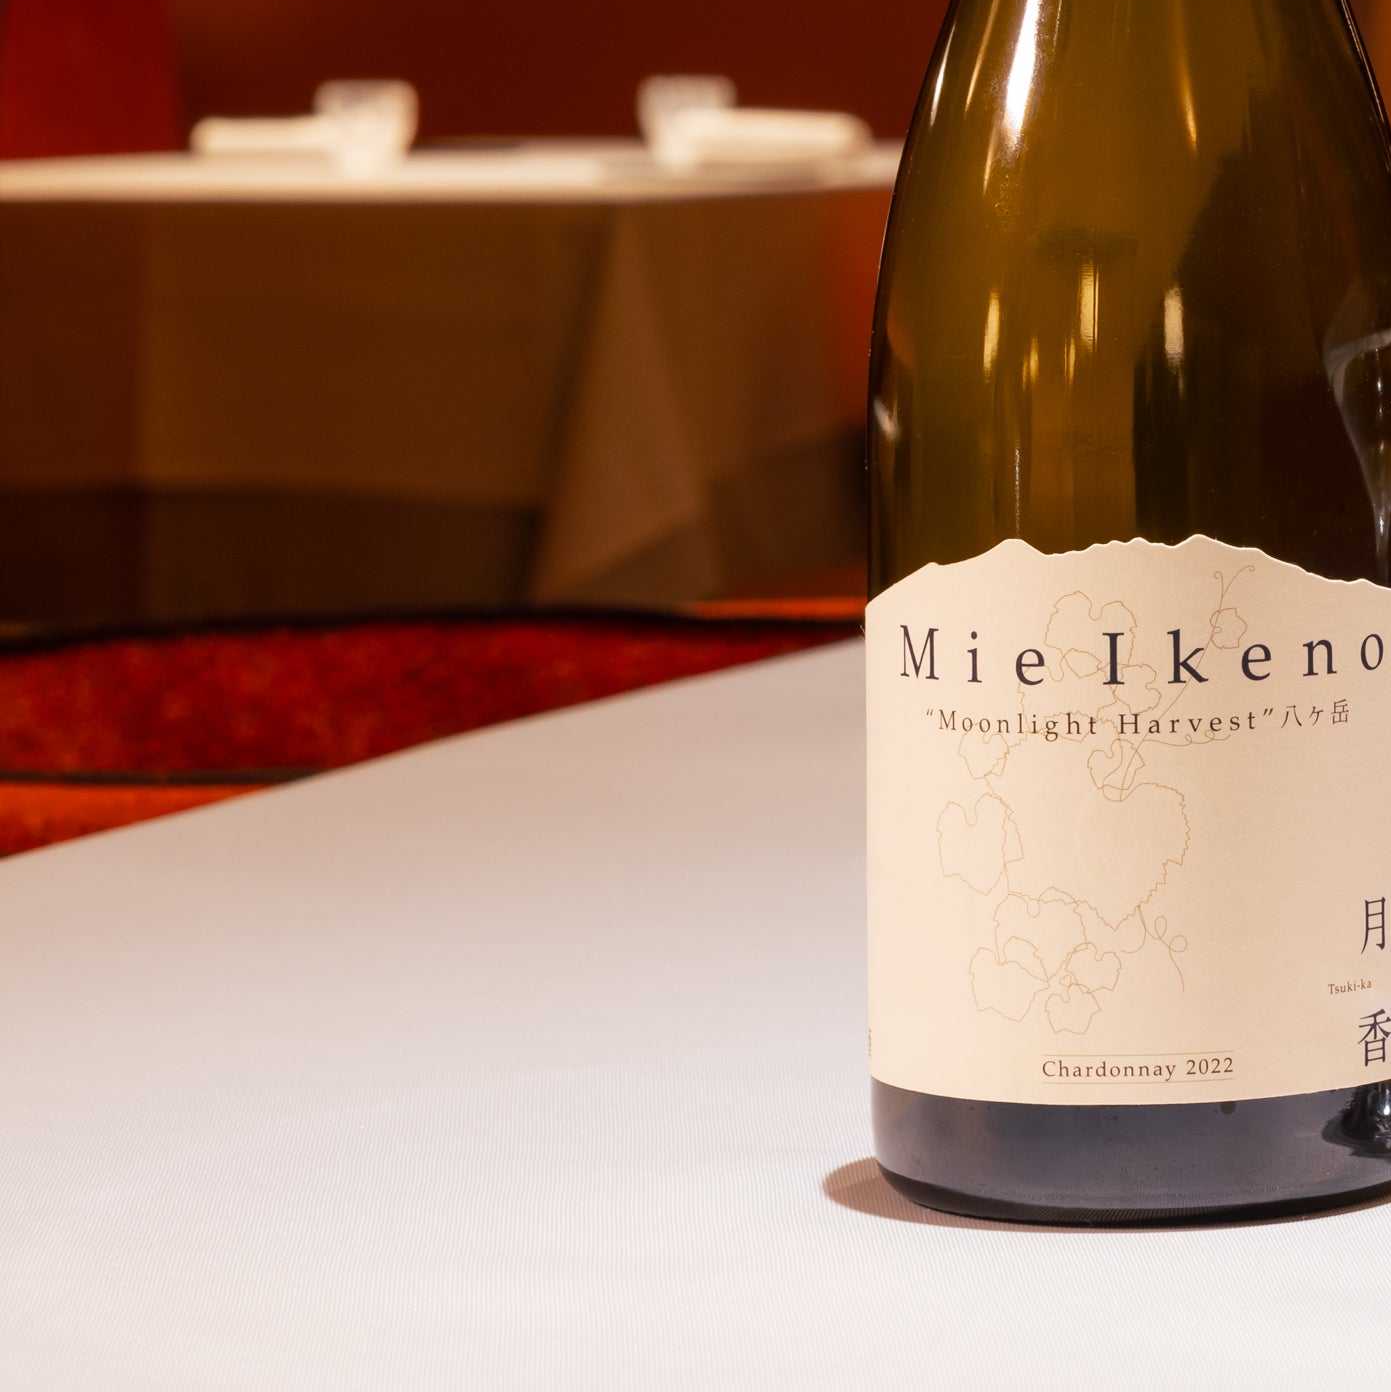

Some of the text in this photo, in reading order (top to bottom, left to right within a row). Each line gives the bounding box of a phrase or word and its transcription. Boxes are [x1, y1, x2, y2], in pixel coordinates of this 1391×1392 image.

[899, 624, 1385, 686] Mie Ikeno
[1327, 978, 1373, 995] Tsuki-ka
[1042, 1057, 1235, 1082] Chardonnay 2022
